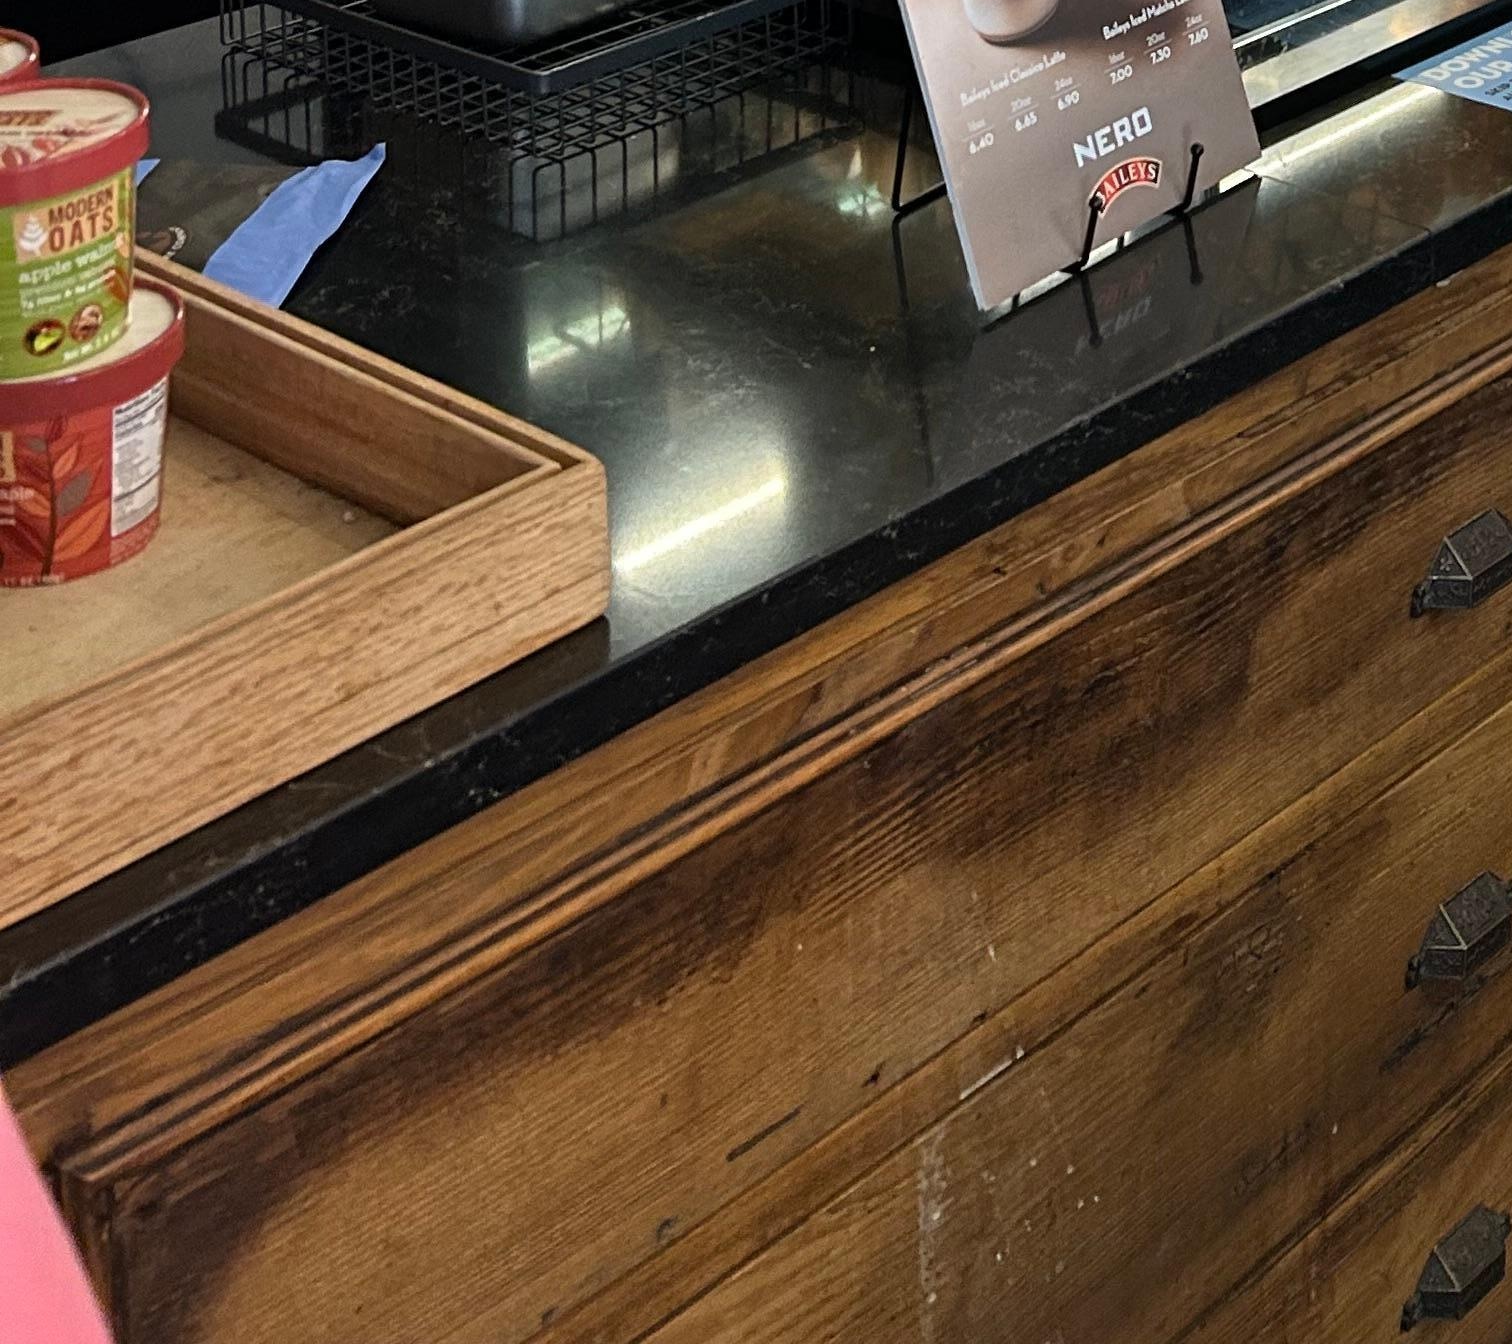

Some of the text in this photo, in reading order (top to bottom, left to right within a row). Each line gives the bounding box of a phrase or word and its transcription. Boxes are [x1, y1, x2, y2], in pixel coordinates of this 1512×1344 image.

[1072, 105, 1154, 168] NERO
[48, 187, 113, 225] MODERN
[50, 206, 113, 252] OATS
